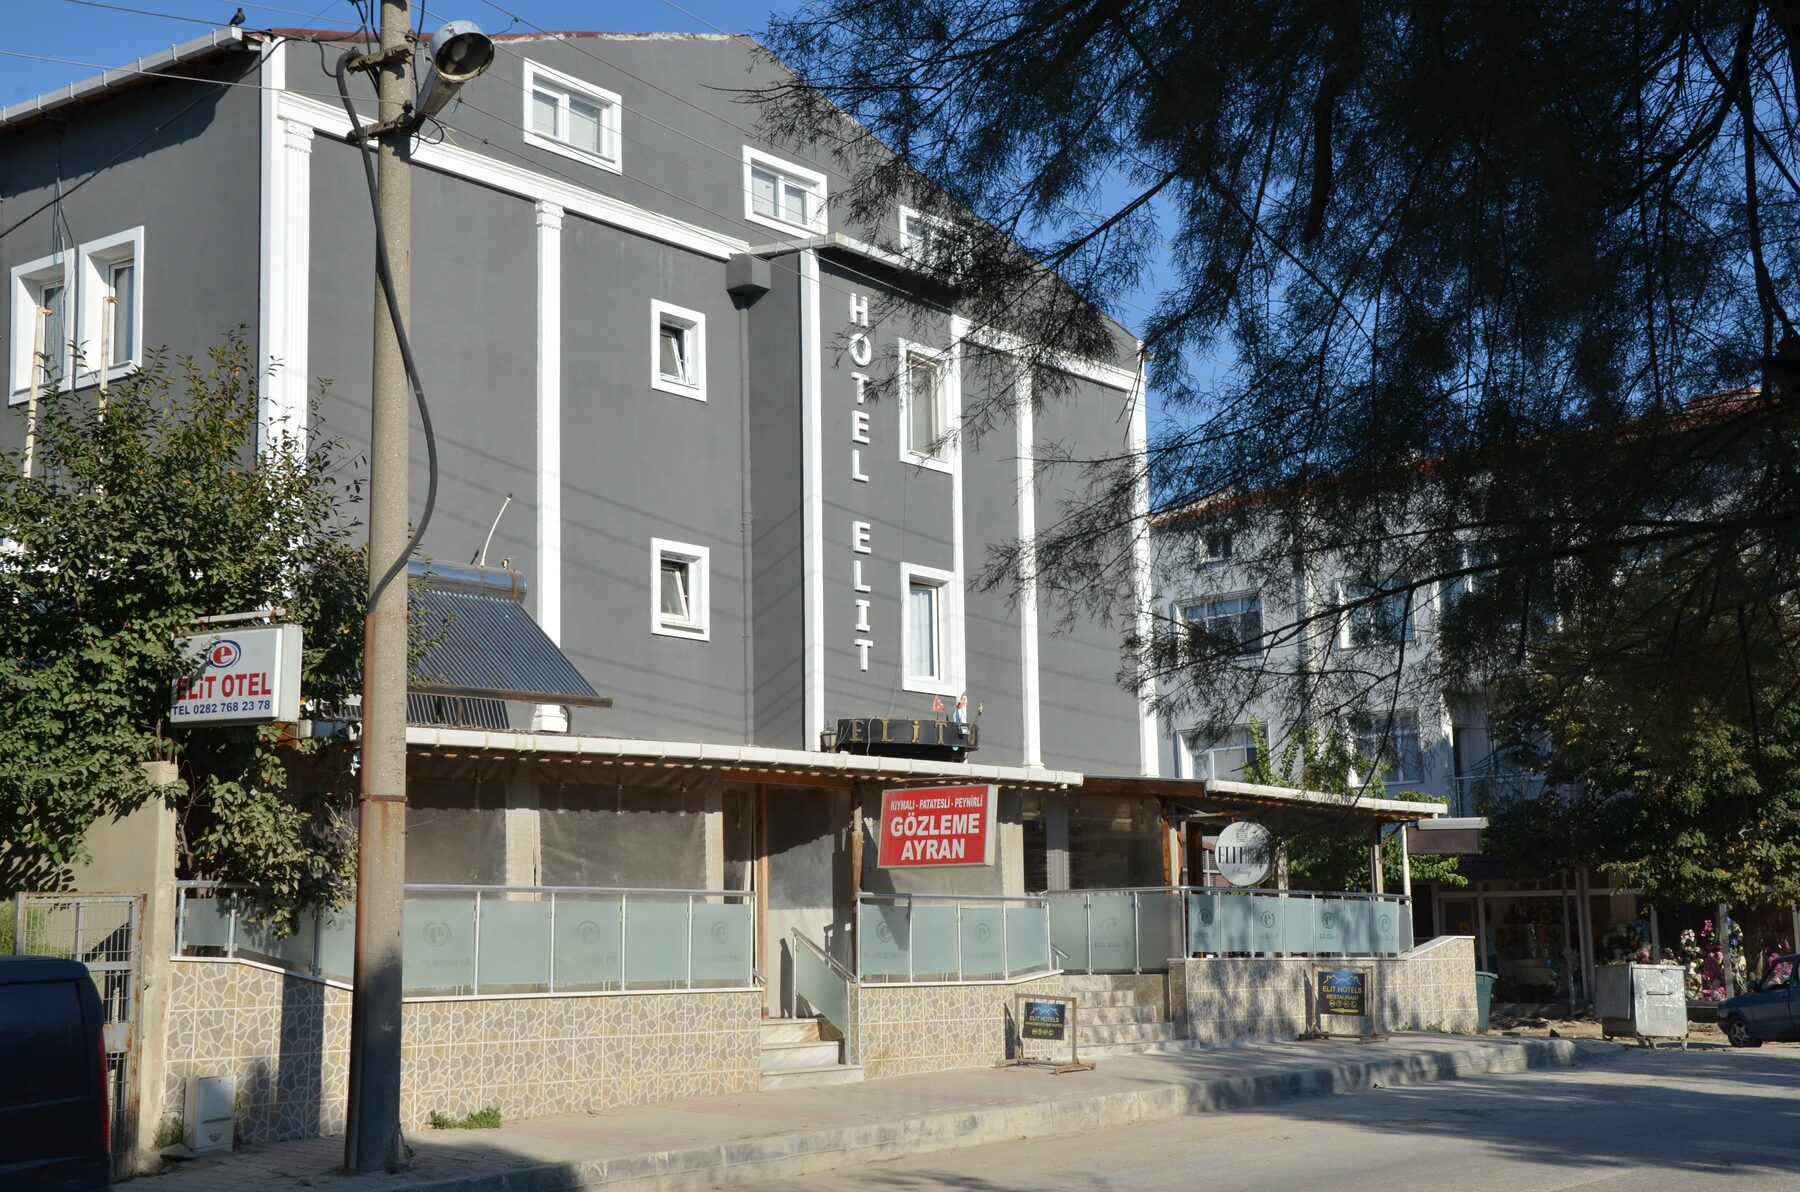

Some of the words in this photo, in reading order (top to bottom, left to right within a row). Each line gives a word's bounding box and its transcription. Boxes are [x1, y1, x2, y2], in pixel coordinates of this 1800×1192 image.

[850, 292, 872, 483] HOTEL
[852, 520, 874, 672] ELIT
[221, 672, 272, 698] OTEL
[172, 705, 190, 716] TEL
[193, 703, 217, 715] 0282
[220, 702, 239, 713] 768
[242, 701, 255, 711] 23
[258, 700, 271, 710] 78
[890, 799, 915, 811] KIYMALI
[890, 811, 981, 837] GÖZLEME
[901, 838, 965, 861] AYRAN
[1322, 985, 1336, 993] ELIT
[1337, 986, 1362, 994] HOTELS
